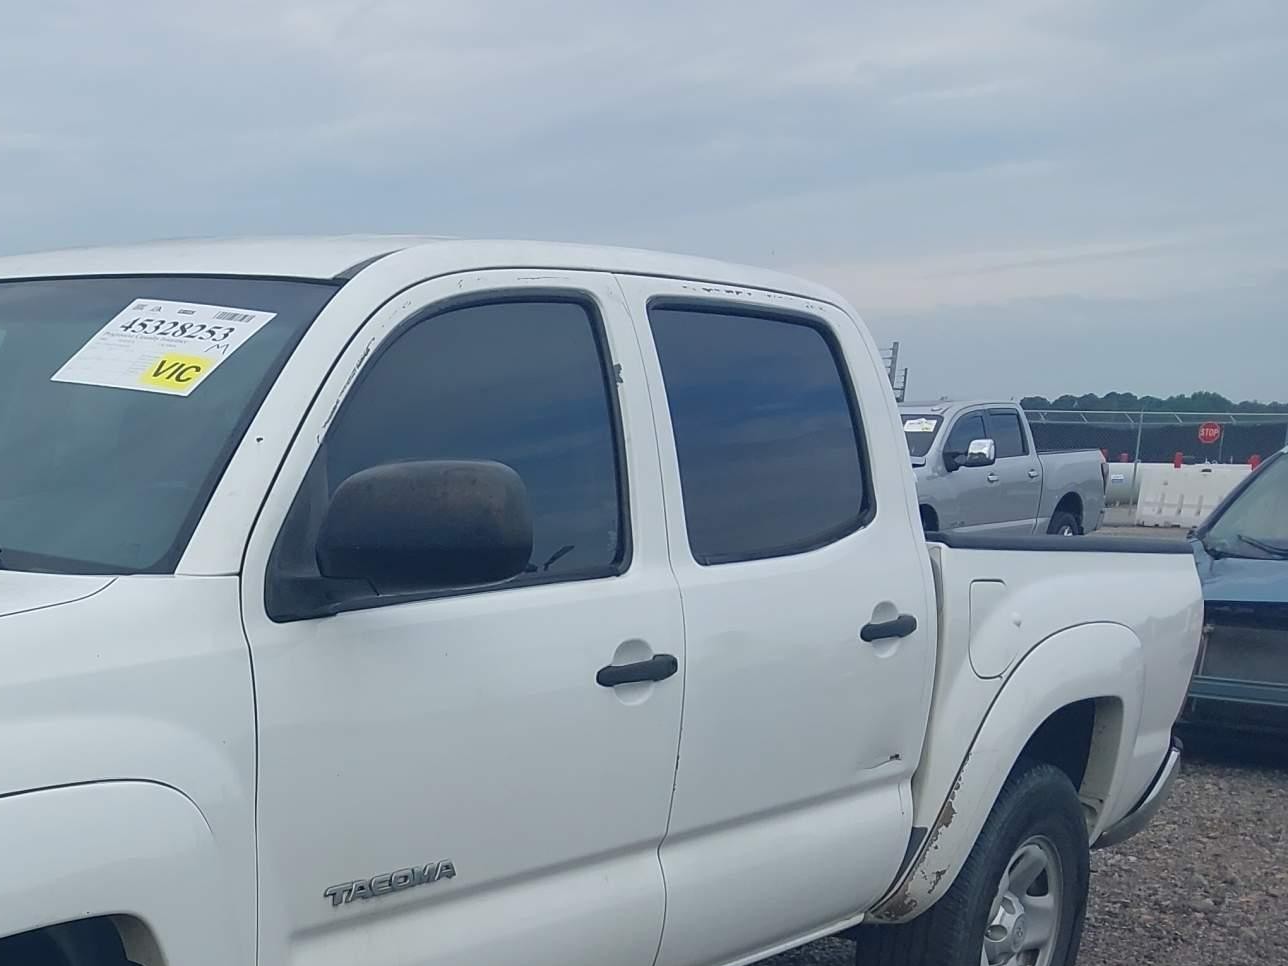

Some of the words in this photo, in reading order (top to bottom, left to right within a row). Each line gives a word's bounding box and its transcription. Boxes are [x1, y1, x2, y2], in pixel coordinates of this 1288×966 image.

[120, 317, 235, 342] 45328253
[153, 359, 201, 383] VIC
[1199, 428, 1219, 437] STOP
[323, 858, 457, 906] TACOMA
